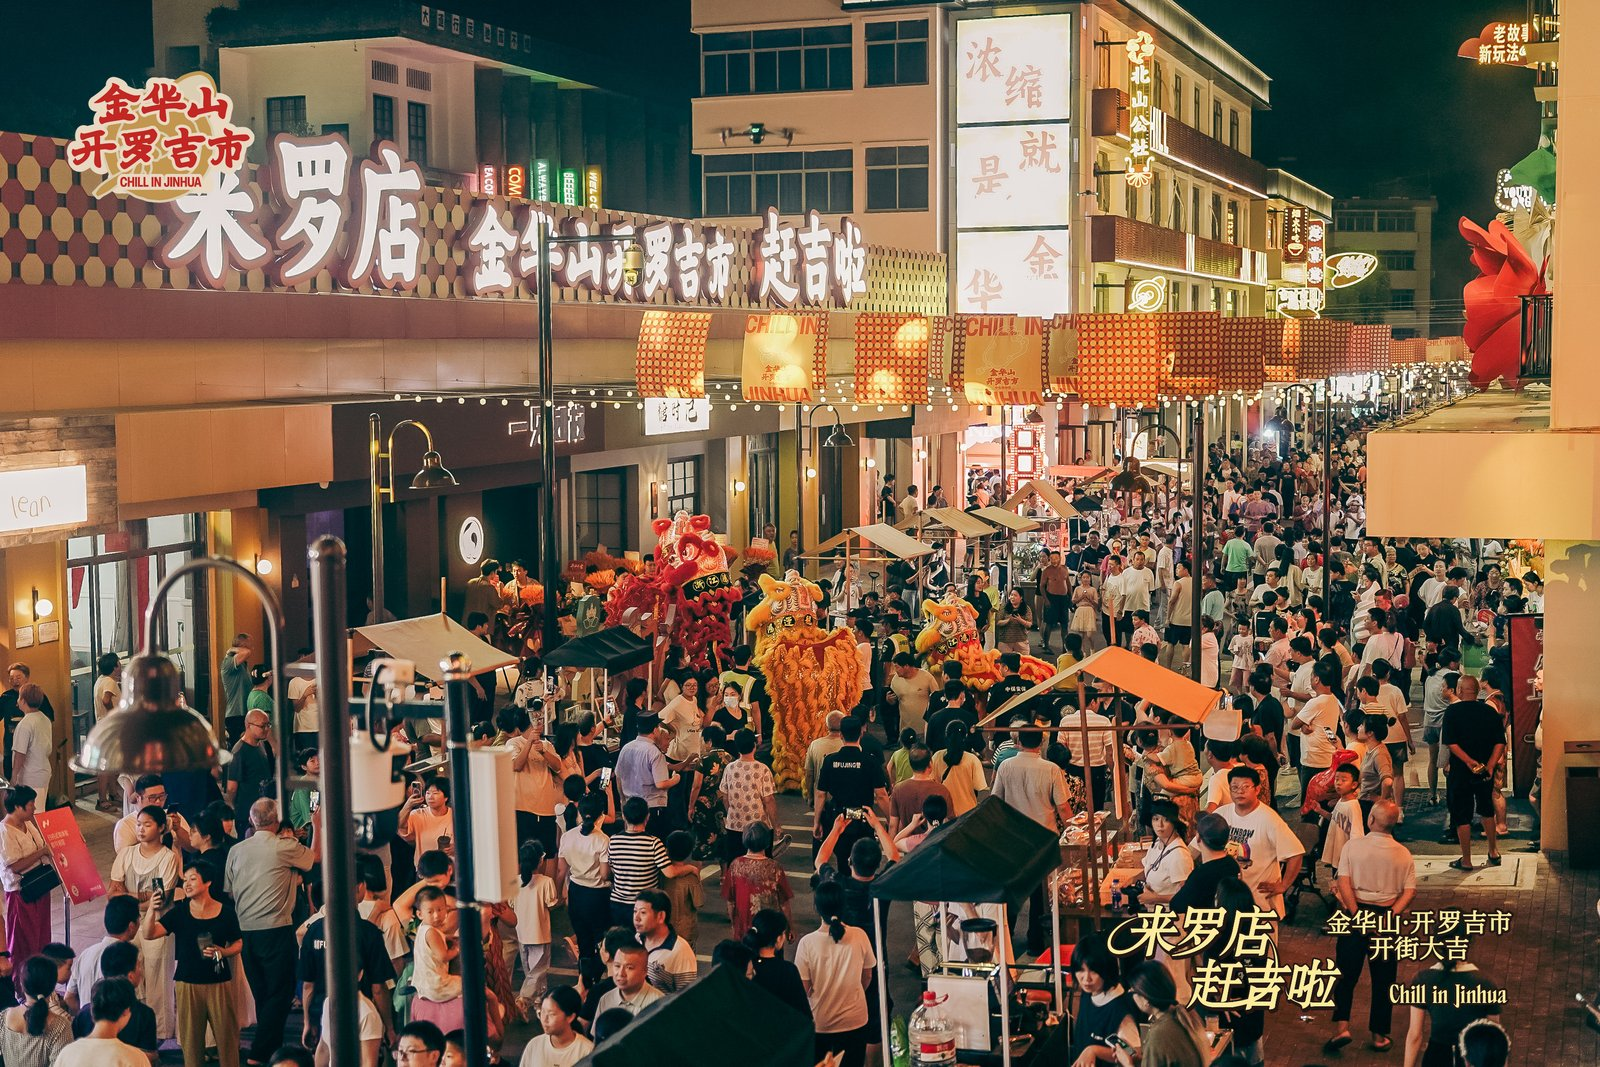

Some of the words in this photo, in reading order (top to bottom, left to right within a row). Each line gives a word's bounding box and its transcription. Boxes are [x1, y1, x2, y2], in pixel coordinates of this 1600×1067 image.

[966, 37, 1042, 108] 浓缩
[1130, 65, 1150, 157] 北山公社
[760, 211, 867, 303] 赶吉啦
[800, 316, 818, 335] IN
[744, 386, 813, 402] JINHUA
[11, 495, 51, 519] lean
